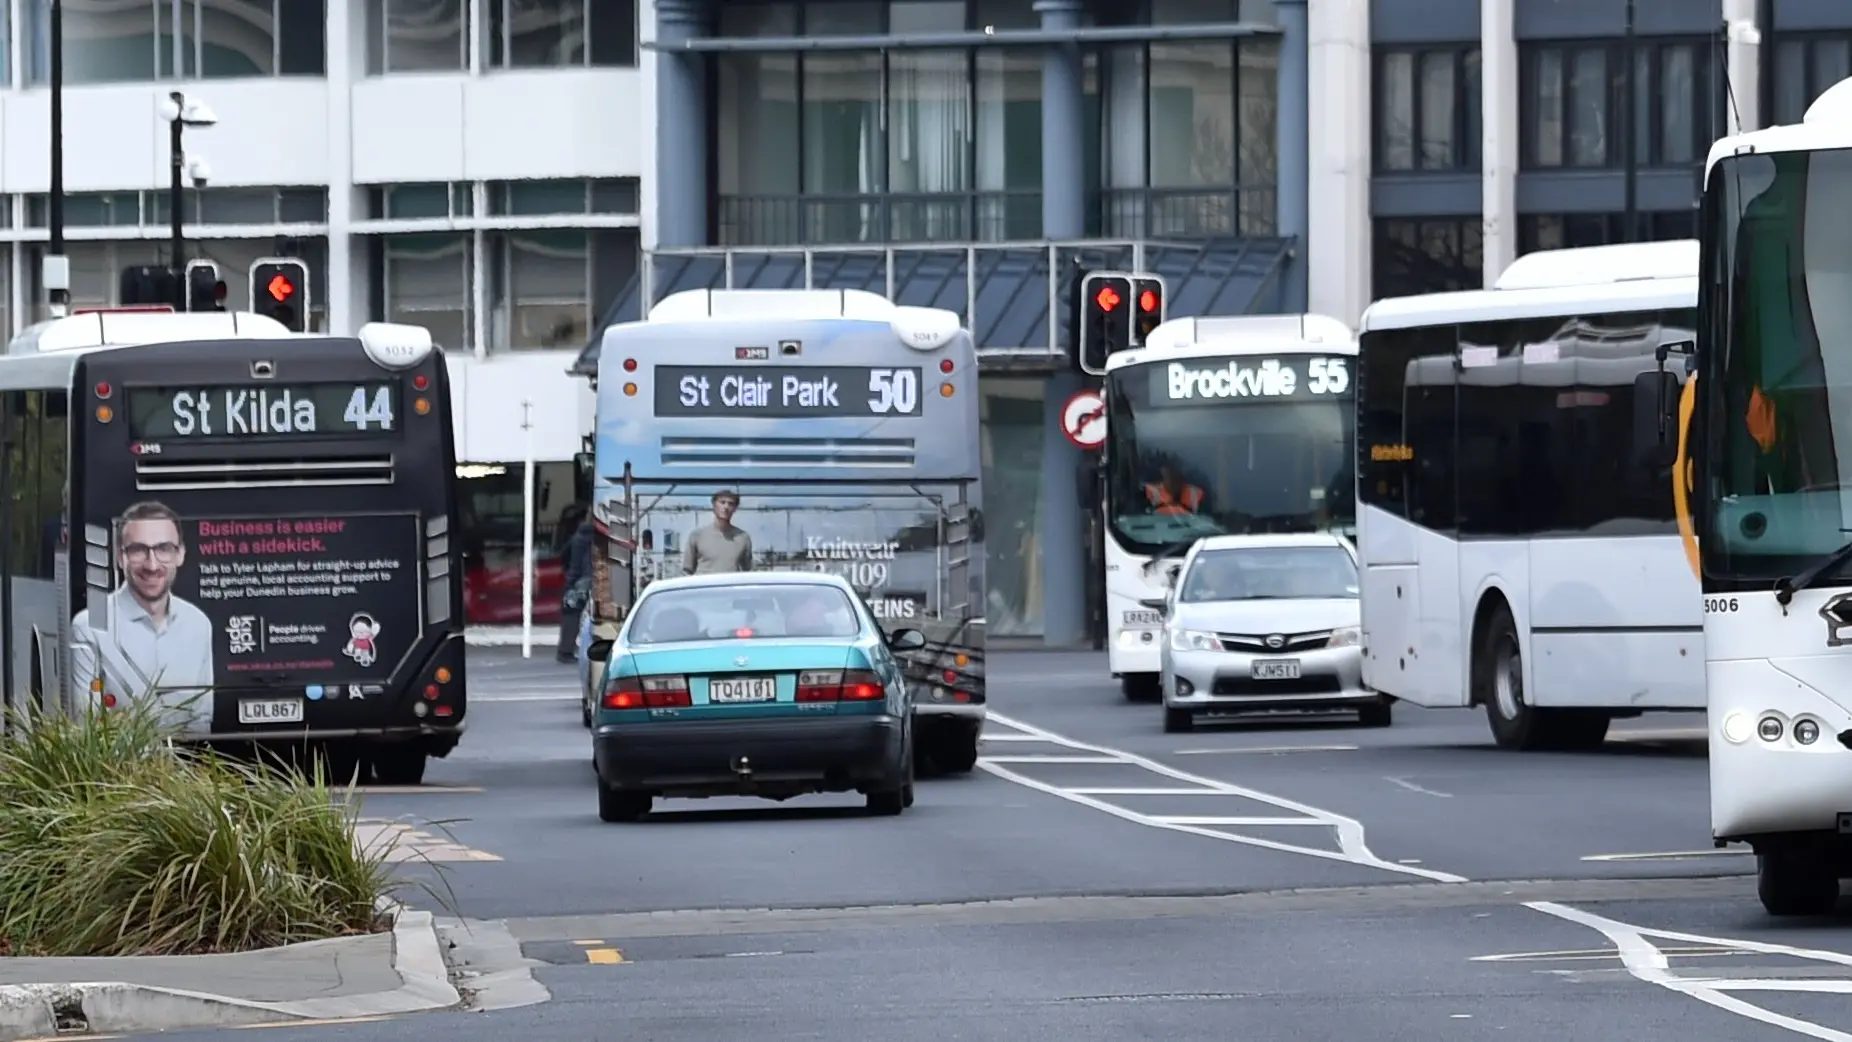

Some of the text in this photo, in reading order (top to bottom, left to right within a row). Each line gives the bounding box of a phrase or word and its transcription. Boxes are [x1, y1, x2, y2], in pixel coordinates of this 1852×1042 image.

[1167, 357, 1349, 399] Brockville 55
[679, 368, 917, 413] St Clair Park 50
[172, 386, 394, 435] St Kilda 44
[199, 518, 345, 536] Business is easier
[199, 537, 327, 555] with a sidekick.
[806, 536, 900, 560] Knitwear
[199, 558, 399, 575] Talk to Tyler Lapham for straight-up advice
[199, 571, 391, 588] and genuine, local accounting support to
[199, 585, 357, 600] help your Dunedin business grow.
[1704, 597, 1739, 613] 5006
[240, 615, 256, 652] kick
[269, 624, 326, 635] People driven
[1253, 664, 1298, 678] KJW511
[712, 681, 772, 699] TQ4101
[244, 703, 297, 718] LQL867
